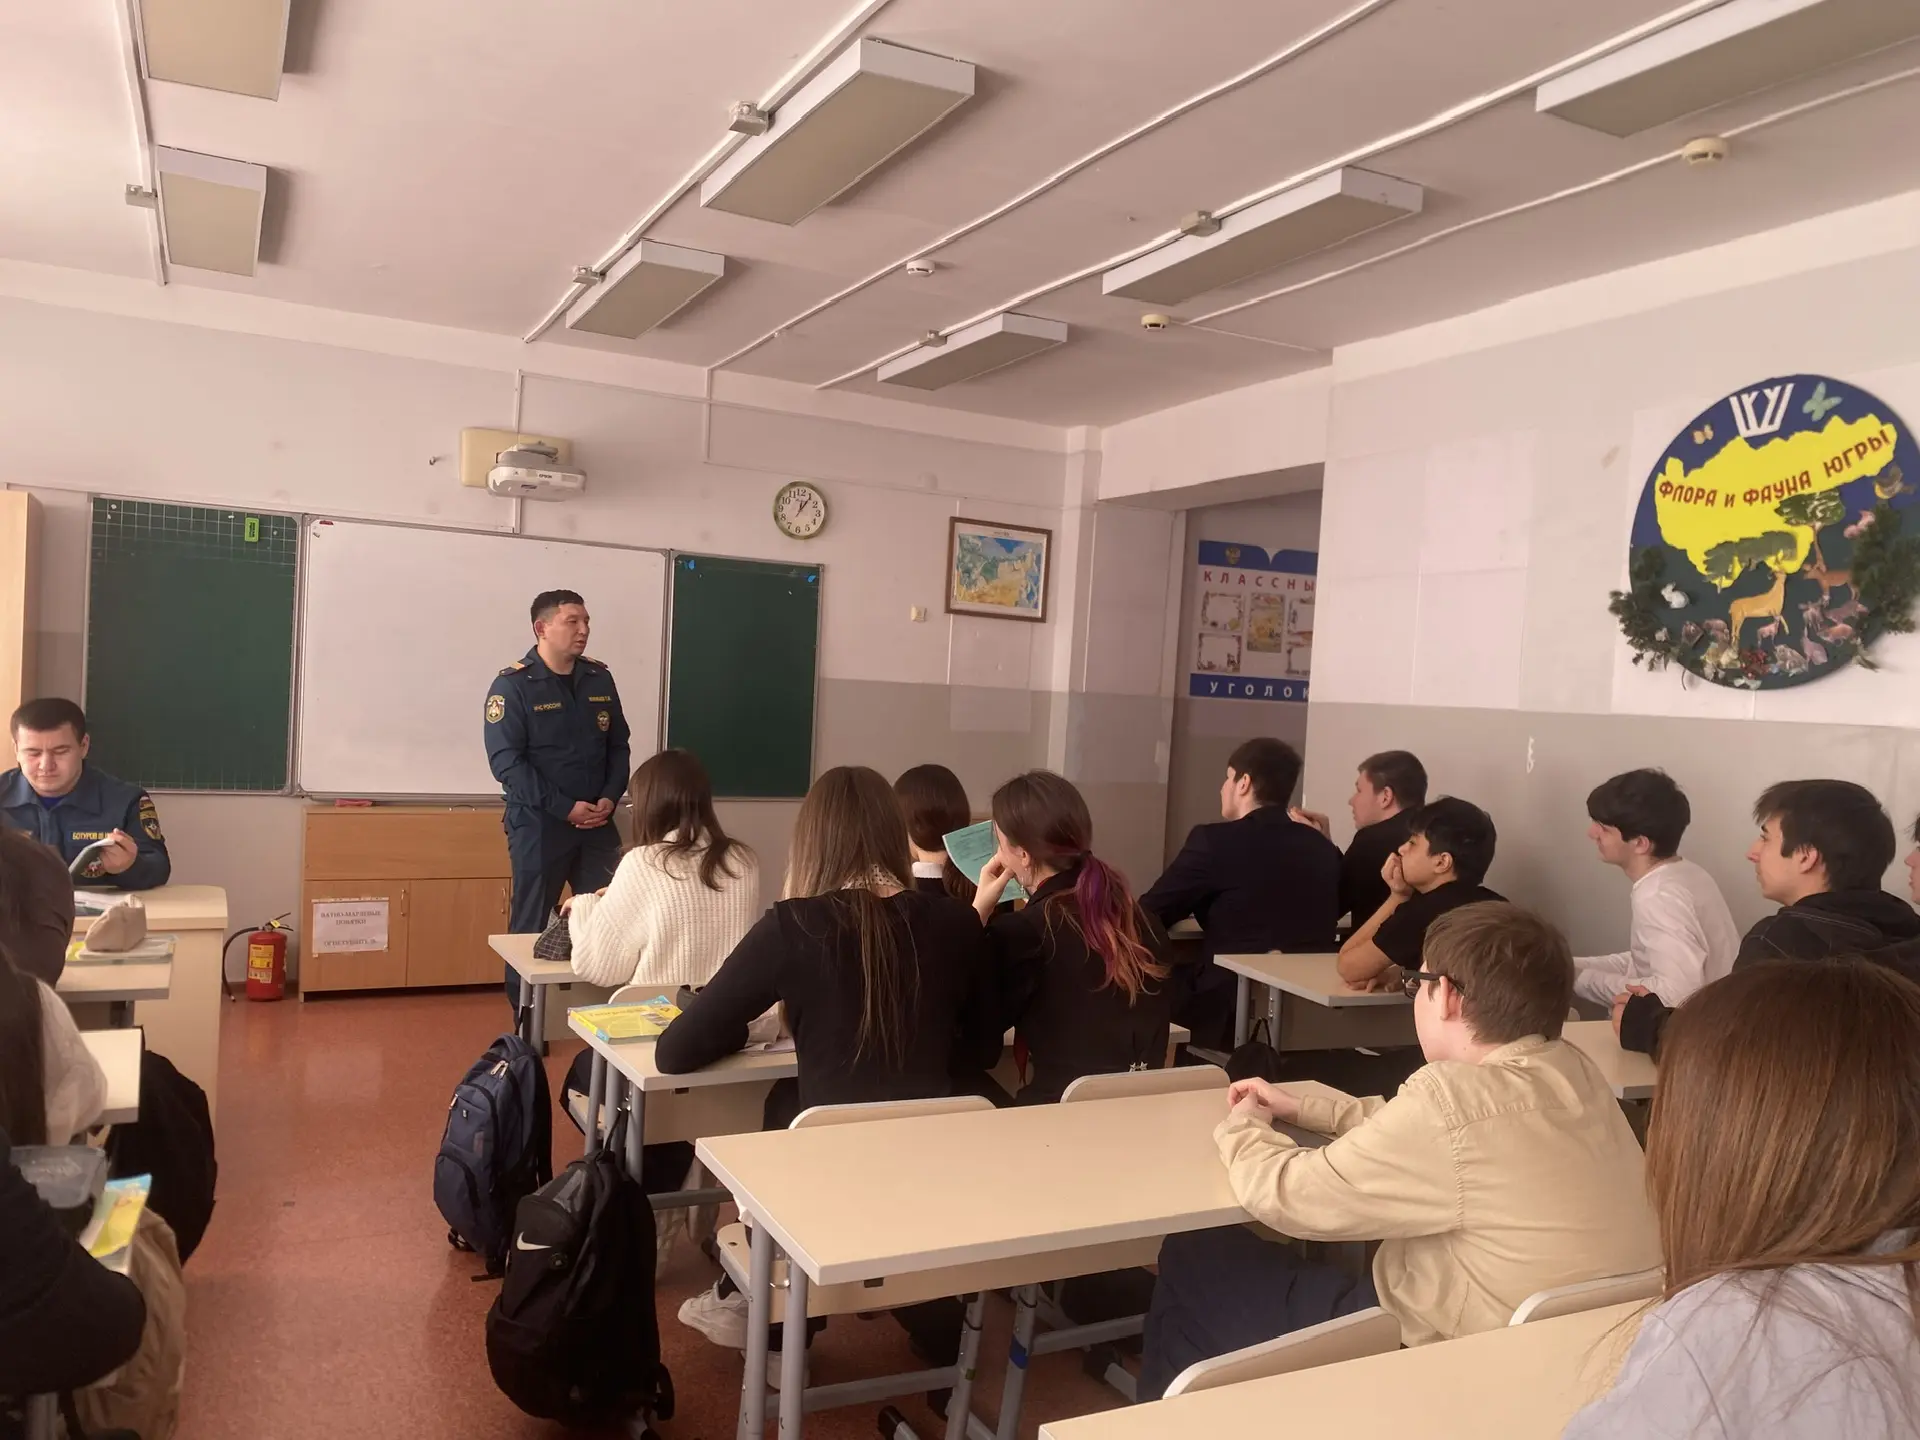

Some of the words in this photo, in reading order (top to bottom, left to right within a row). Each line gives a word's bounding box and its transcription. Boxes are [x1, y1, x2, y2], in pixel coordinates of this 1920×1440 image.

[1659, 481, 1717, 507] ФЛОРА
[1743, 470, 1811, 506] ФАУНА
[1823, 429, 1890, 478] ЮГРЫ
[796, 489, 807, 497] 12
[782, 497, 791, 505] 10
[812, 501, 818, 509] 2
[778, 505, 784, 513] 9
[780, 513, 786, 521] 8
[816, 510, 821, 518] 3
[788, 522, 792, 530] 7
[794, 526, 801, 534] 6
[804, 524, 811, 532] 5
